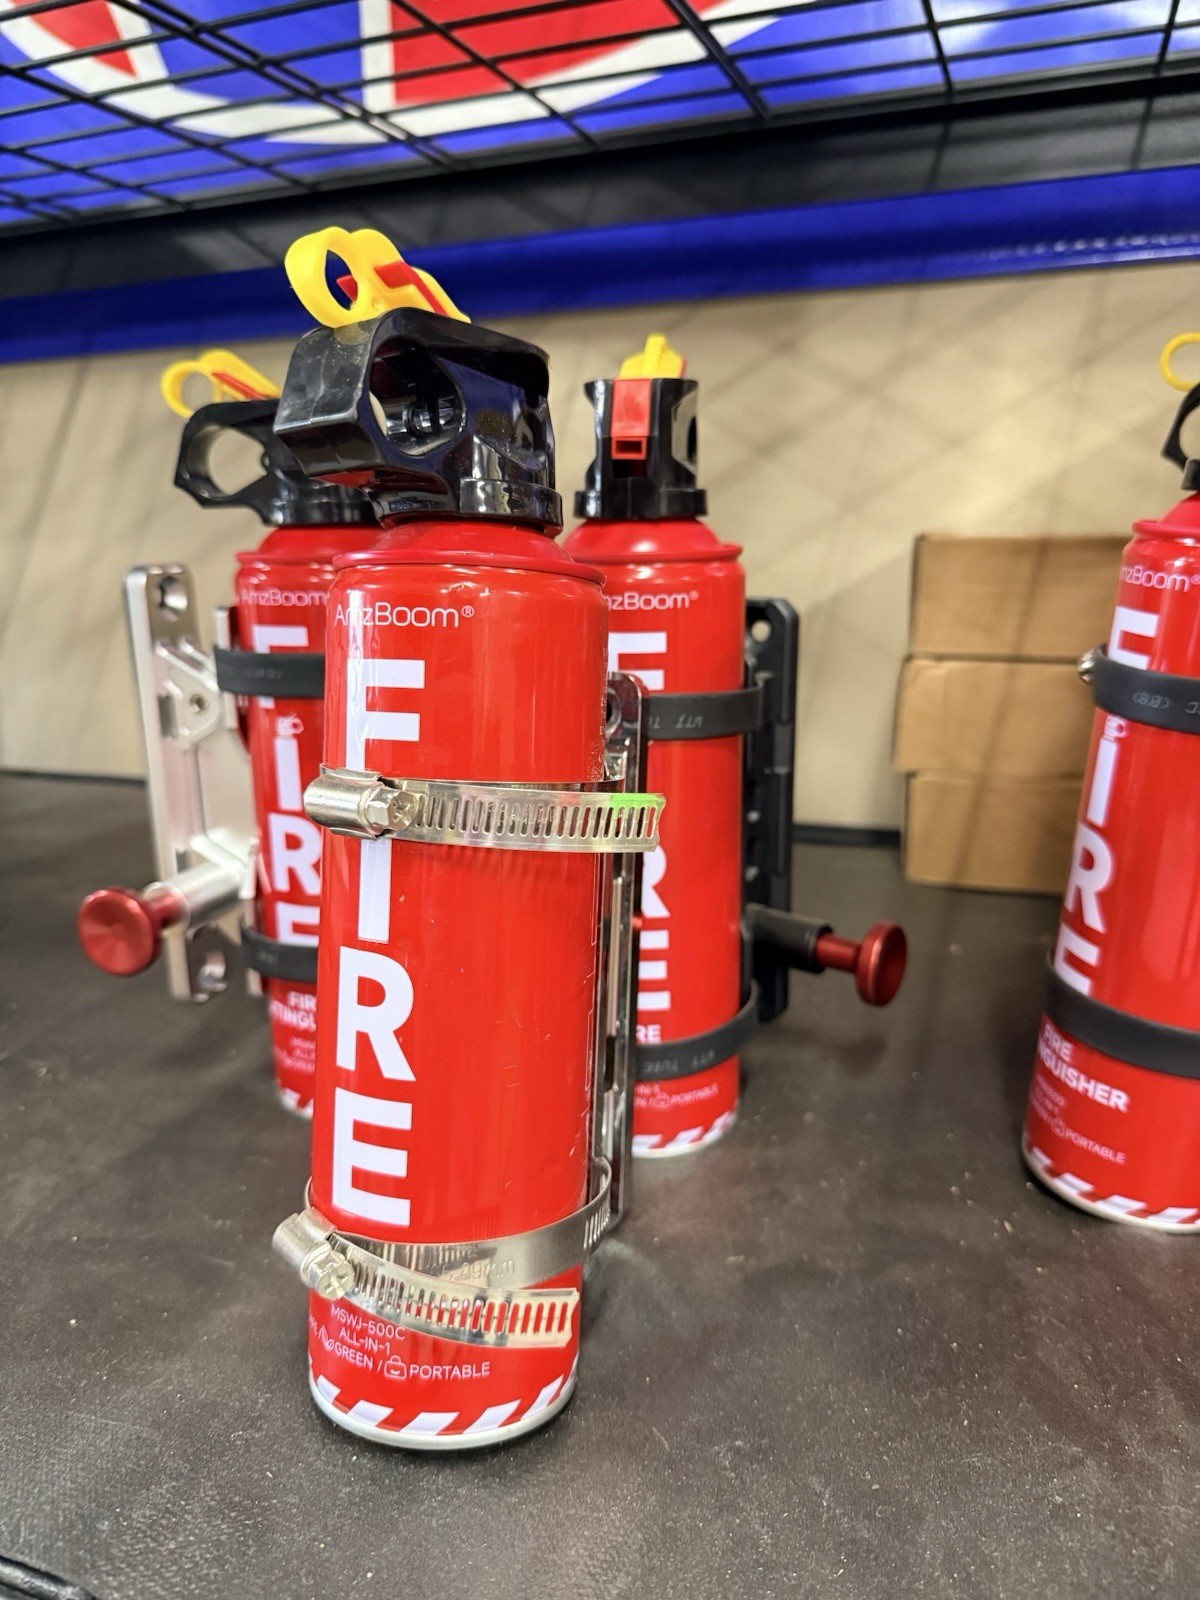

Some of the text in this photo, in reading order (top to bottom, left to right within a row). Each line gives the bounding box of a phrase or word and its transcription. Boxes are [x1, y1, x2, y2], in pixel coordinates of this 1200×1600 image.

[333, 658, 426, 1228] FIRE
[331, 1303, 405, 1341] MSWJ-500C
[339, 1326, 390, 1355] ALL-IN-1
[334, 1341, 374, 1370] GREEN
[410, 1361, 490, 1380] PORTABLE
